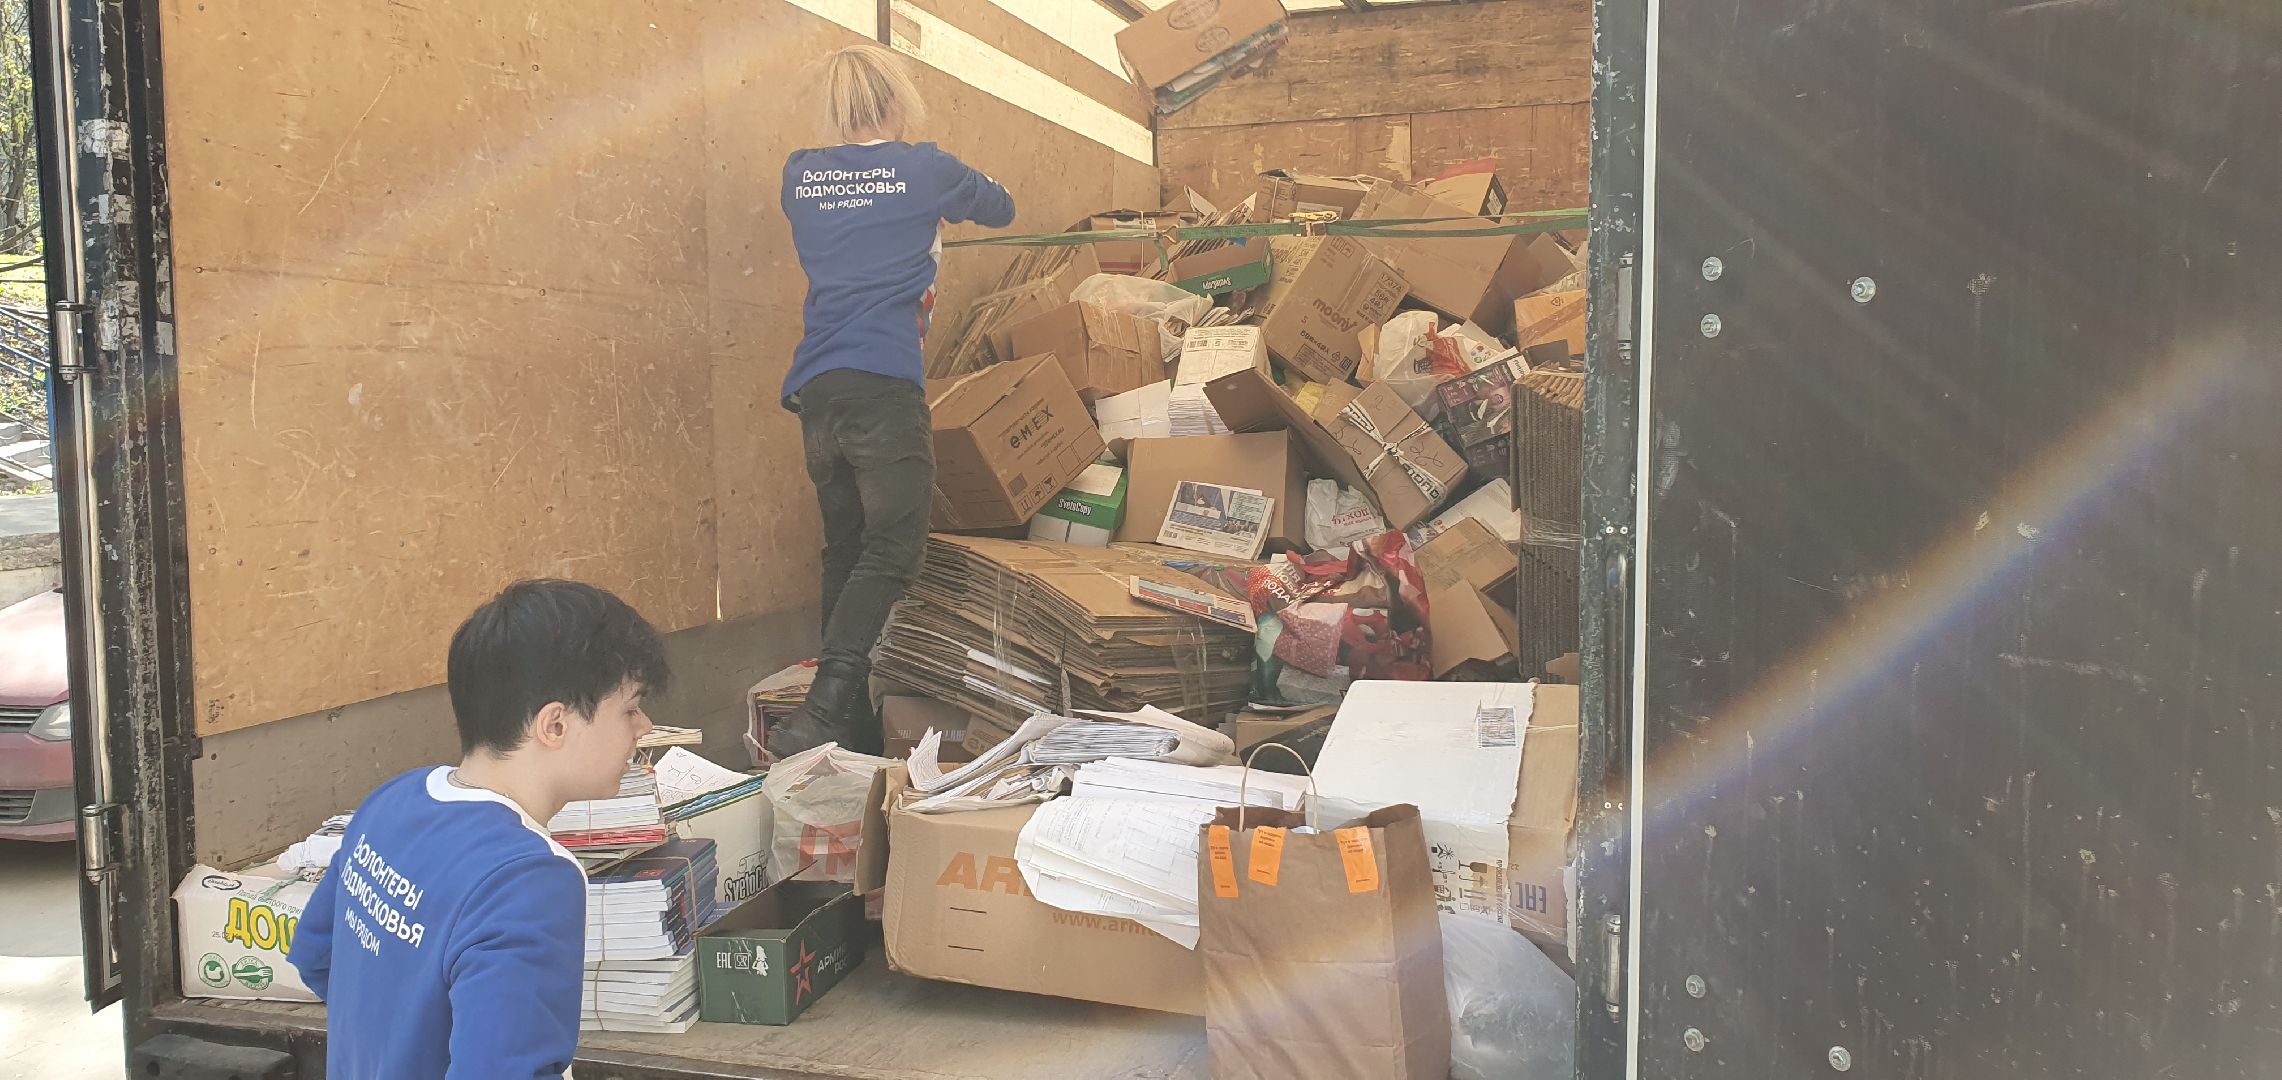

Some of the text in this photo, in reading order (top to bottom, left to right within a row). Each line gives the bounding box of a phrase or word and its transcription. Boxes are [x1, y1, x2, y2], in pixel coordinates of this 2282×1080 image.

[795, 181, 907, 200] ПОДМОСКОВЬЯ
[802, 167, 896, 184] ВОЛОНТЕРЫ
[819, 198, 873, 211] МЫ РЯДОМ
[352, 833, 424, 911] ВОЛОНТЕРЫ
[936, 850, 1033, 897] AR
[341, 855, 425, 949] ПОДМОСКОВЬЯ
[1514, 881, 1547, 914] EAC
[344, 906, 381, 957] МЫ РЯДОМ
[716, 951, 732, 968] EAC
